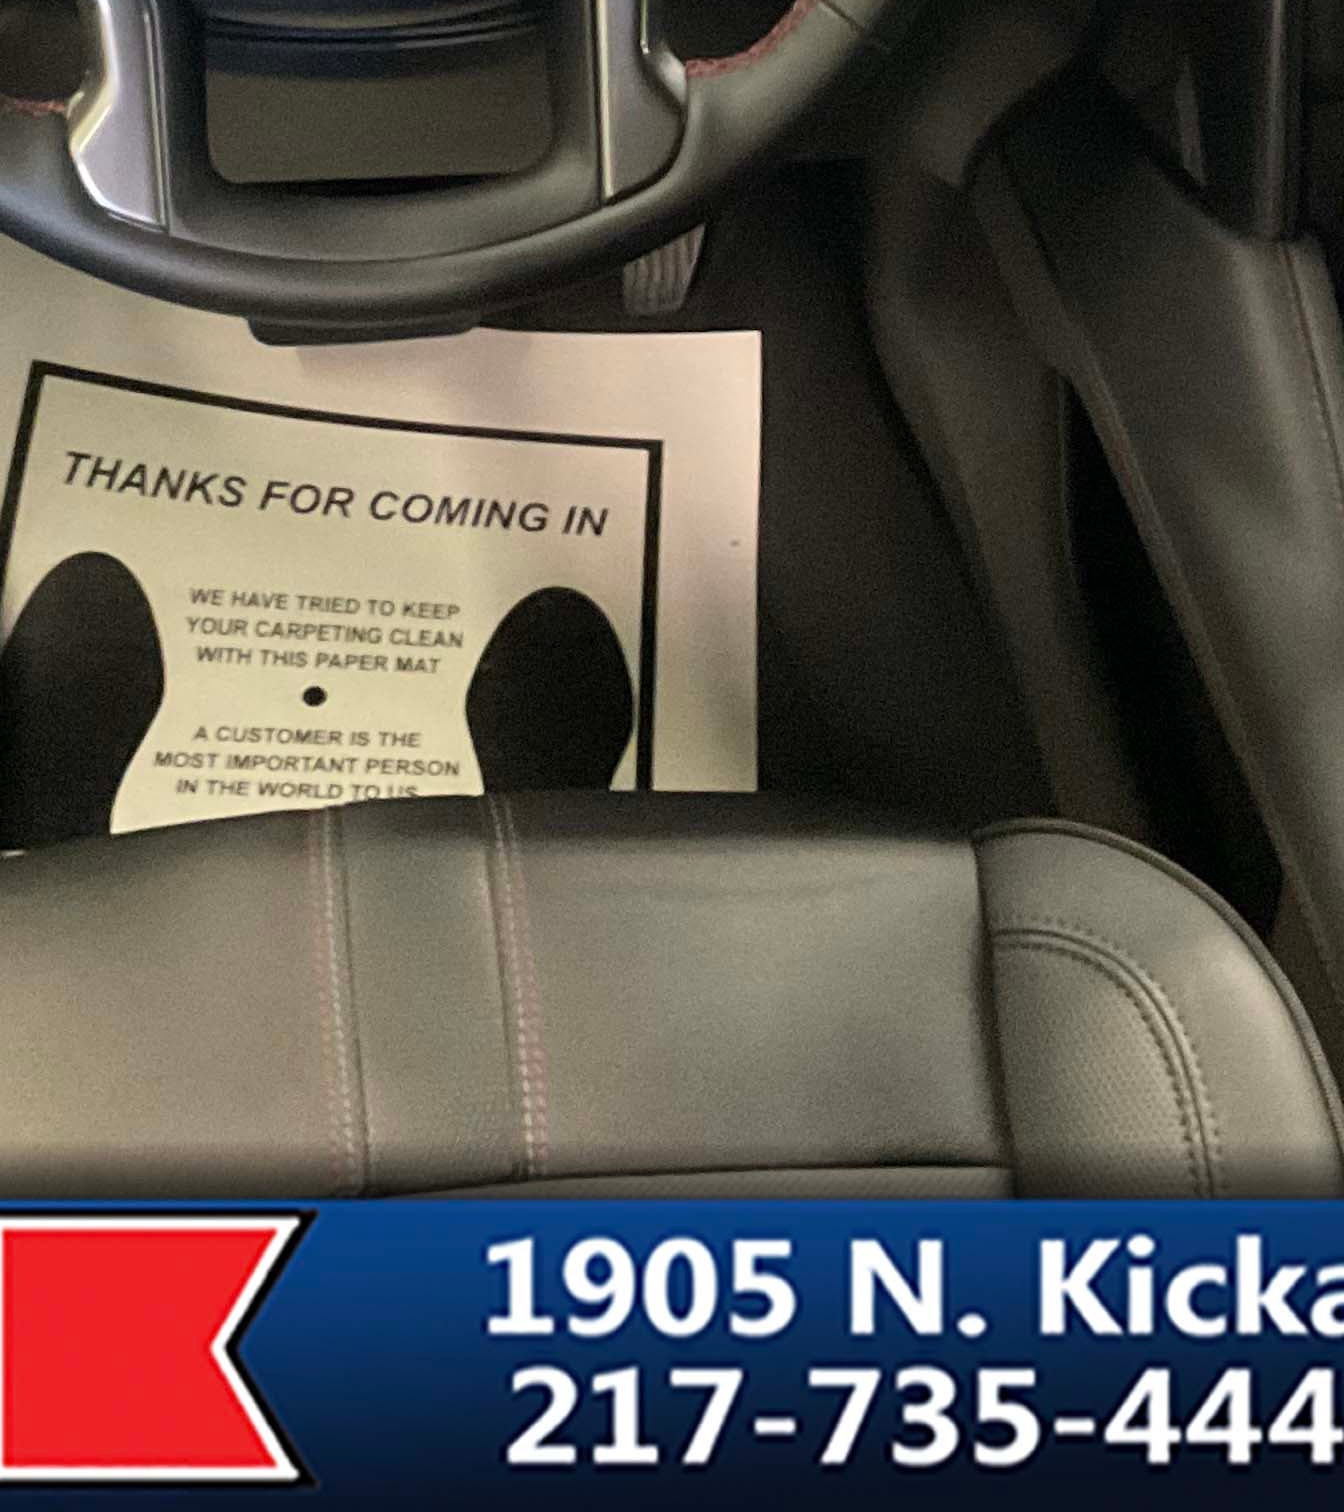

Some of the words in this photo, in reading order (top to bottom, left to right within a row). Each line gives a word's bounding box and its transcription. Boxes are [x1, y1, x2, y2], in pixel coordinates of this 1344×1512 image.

[63, 451, 246, 508] THANKS
[259, 480, 355, 517] FOR
[370, 490, 549, 532] COMING
[563, 506, 608, 537] IN
[189, 588, 224, 606] WE
[231, 590, 289, 611] HAVE
[296, 595, 361, 615] TRIED
[368, 599, 395, 617] TO
[402, 602, 461, 620] KEEP
[186, 616, 248, 636] YOUR
[255, 620, 384, 645] CARPETING
[389, 627, 464, 648] CLEAN
[196, 646, 252, 665] WITH
[260, 649, 307, 668] THIS
[315, 653, 388, 672] PAPER
[395, 656, 440, 674] MAT
[193, 726, 208, 742] A
[215, 726, 343, 746] CUSTOMER
[350, 731, 371, 747] IS
[379, 731, 422, 748] THE
[154, 751, 218, 770] MOST
[226, 754, 357, 774] IMPORTANT
[364, 758, 461, 777] PERSON
[175, 778, 198, 795] IN
[206, 779, 249, 796] THE
[258, 781, 343, 799] WORLD
[352, 784, 380, 801] TO
[387, 785, 419, 799] US
